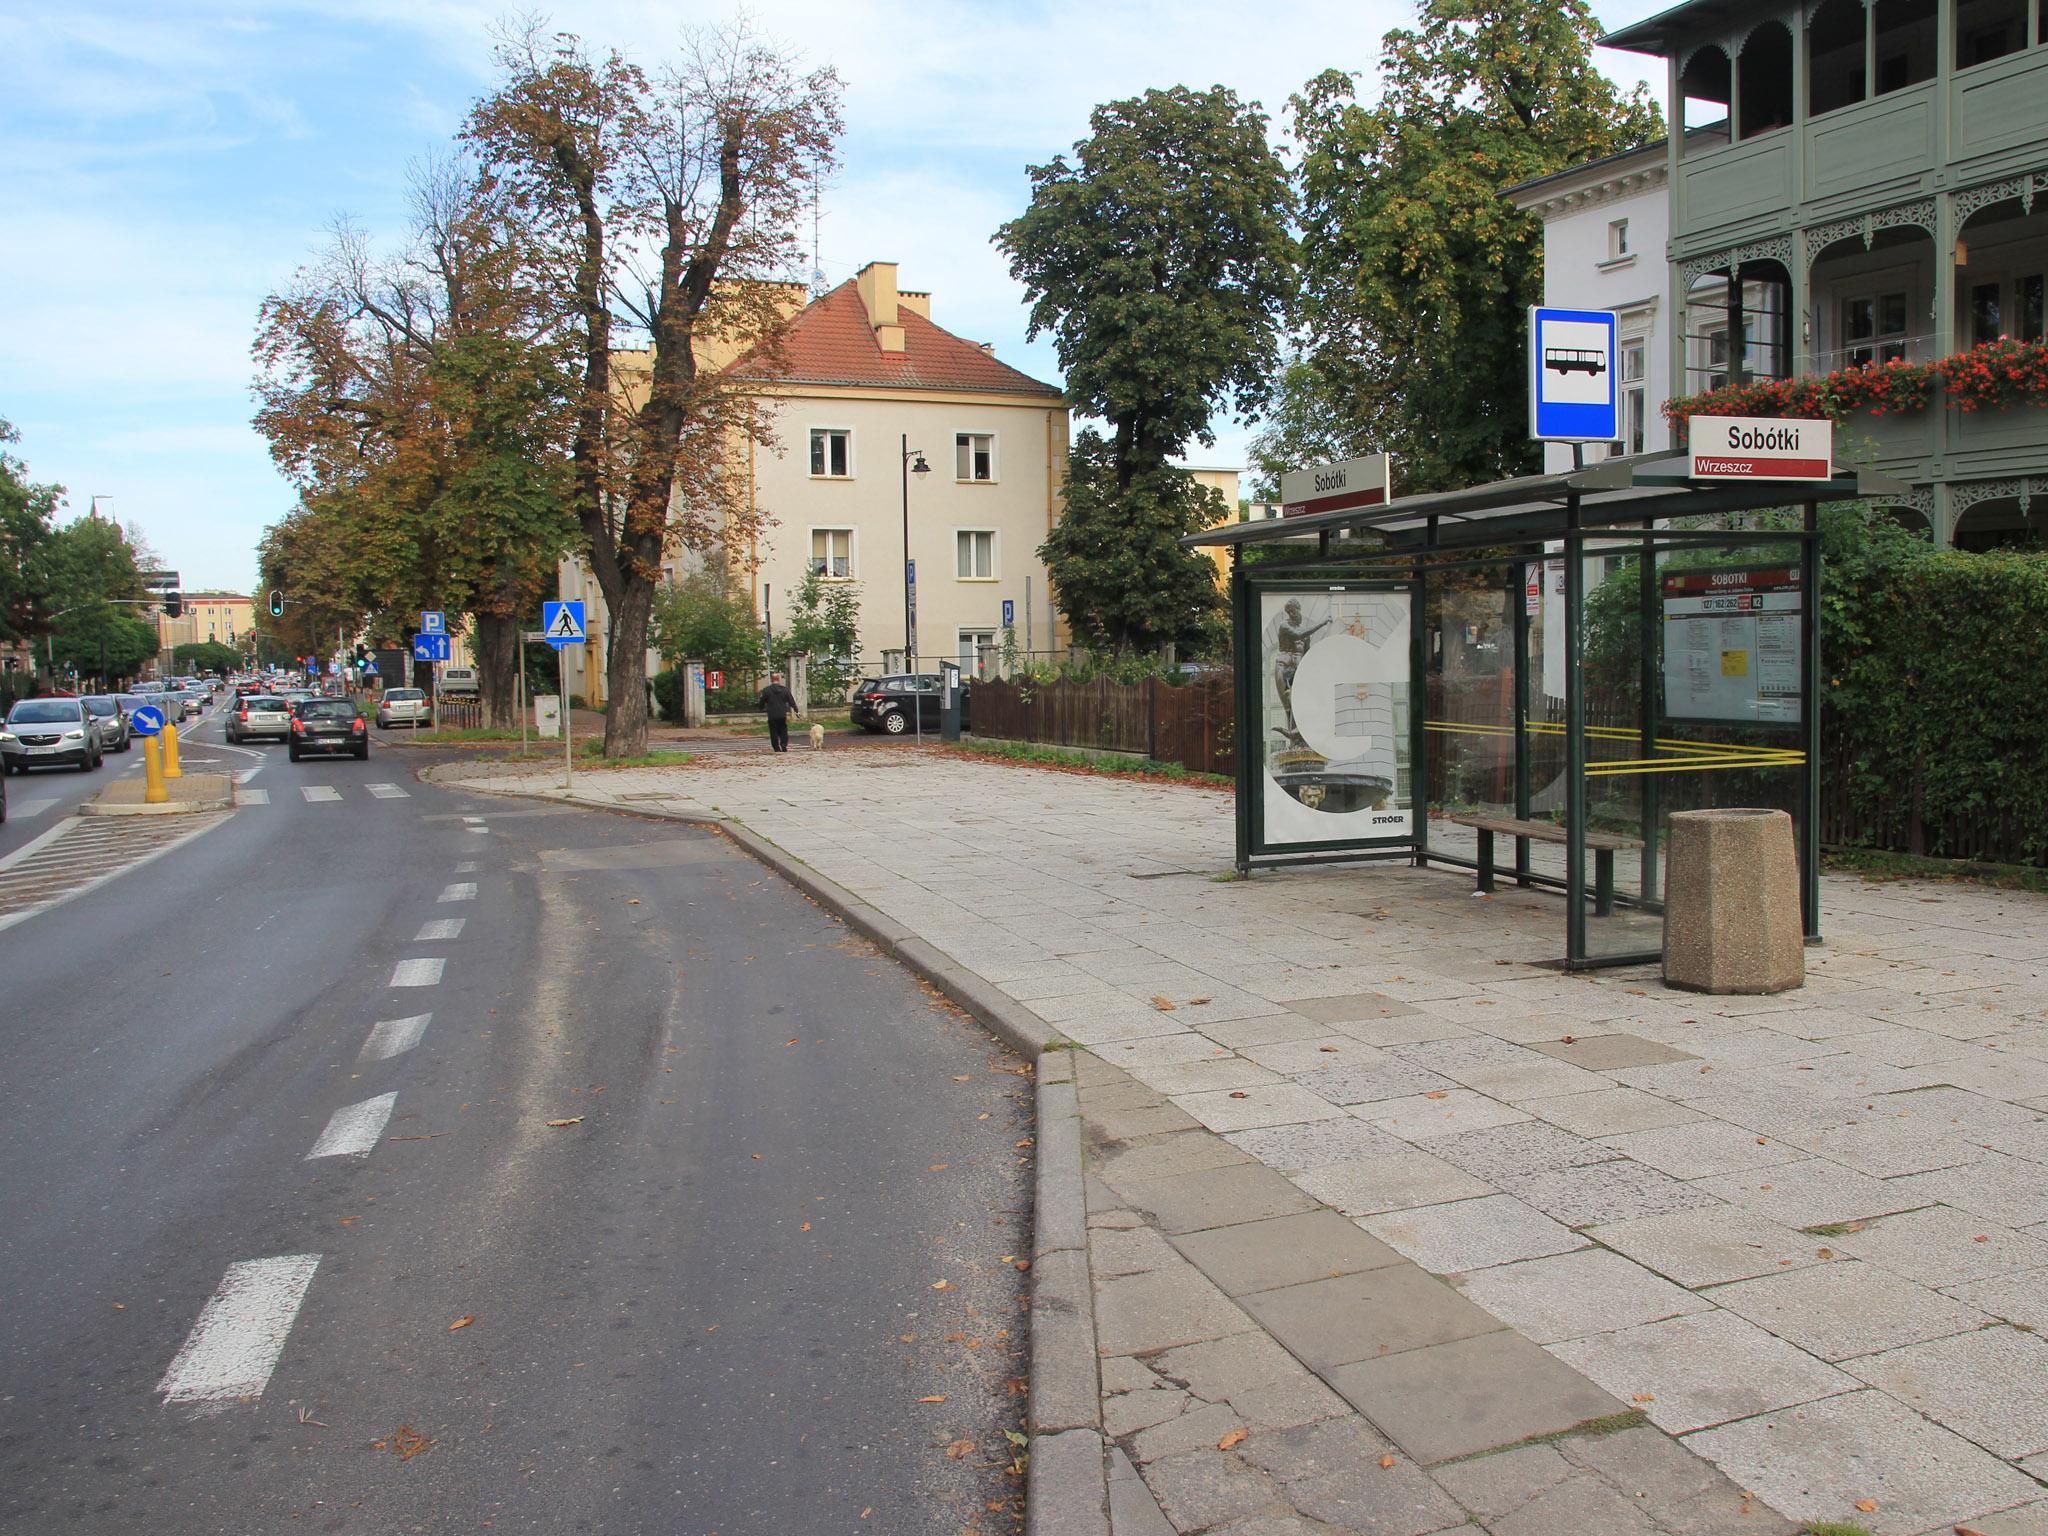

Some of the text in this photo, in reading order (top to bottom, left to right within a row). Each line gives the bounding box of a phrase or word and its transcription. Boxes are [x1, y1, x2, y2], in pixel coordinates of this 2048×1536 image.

[1728, 425, 1799, 451] Sobótki
[1697, 459, 1753, 474] Wrzeszcz
[1314, 469, 1347, 493] Sobótki
[1711, 572, 1747, 586] SOBOTKI
[1703, 599, 1712, 609] 127
[1715, 598, 1725, 609] 162
[1726, 598, 1737, 608] 262
[425, 614, 440, 632] P
